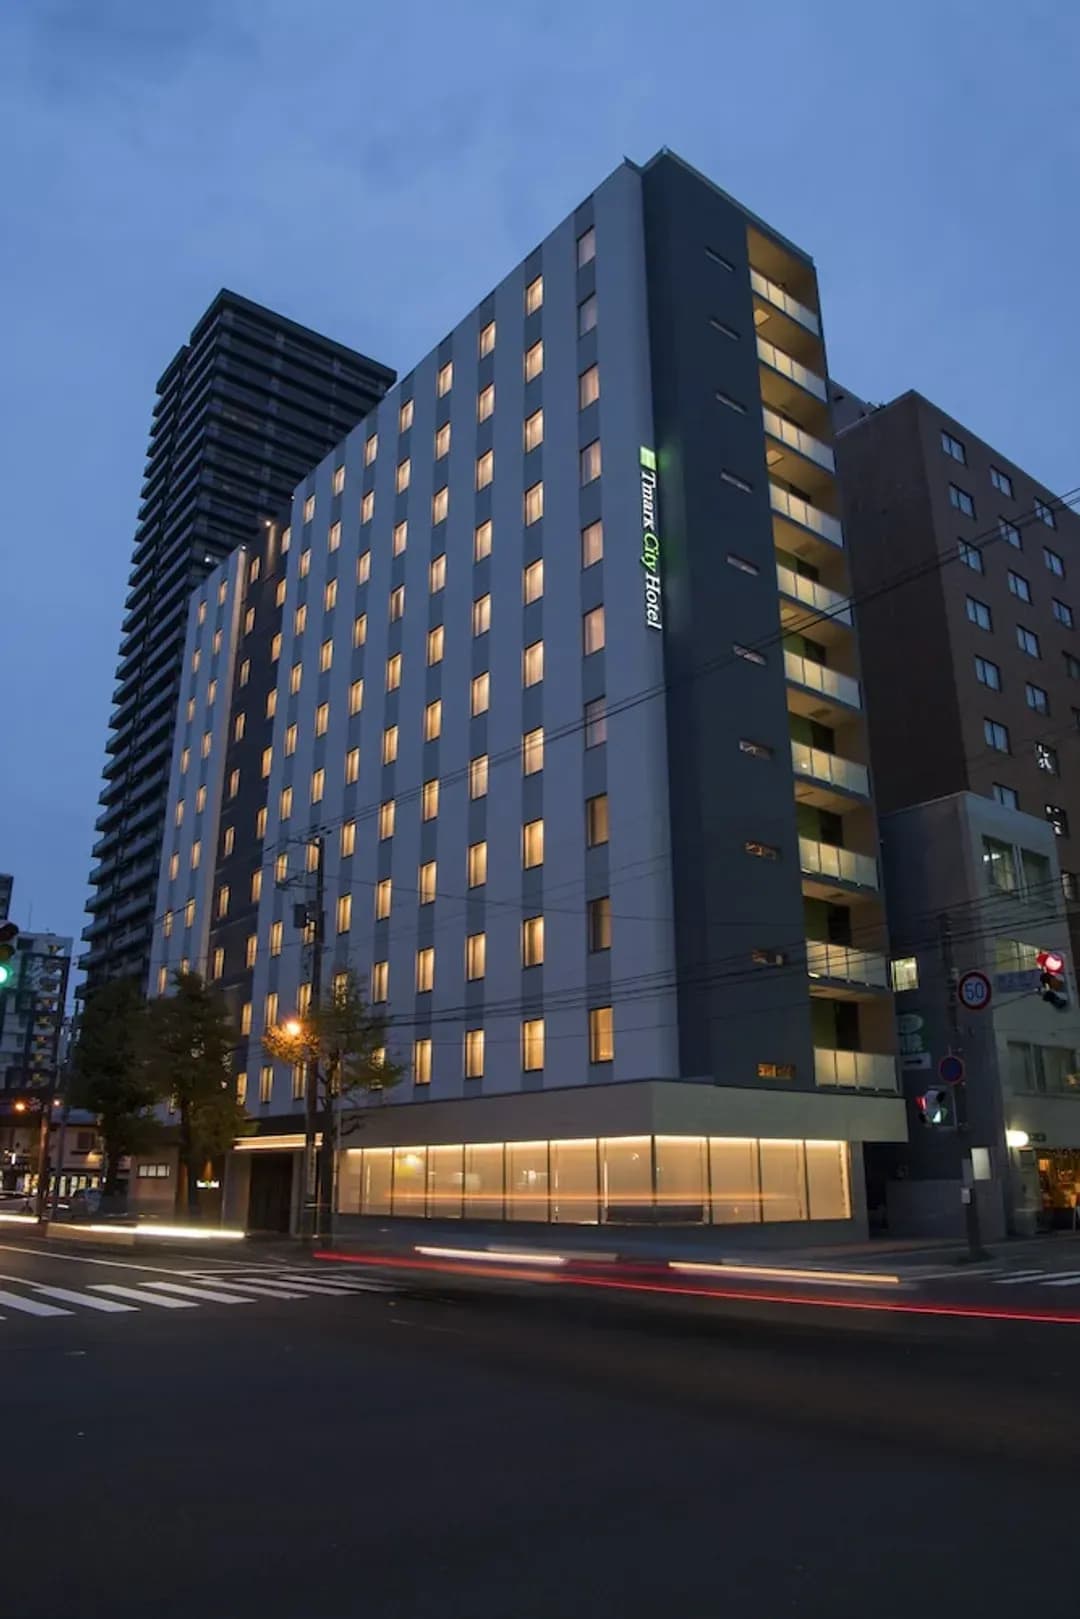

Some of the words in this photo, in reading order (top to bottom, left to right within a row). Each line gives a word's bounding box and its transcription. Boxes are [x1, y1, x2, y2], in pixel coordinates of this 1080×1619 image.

[641, 471, 656, 530] Tmark
[640, 533, 659, 572] City
[645, 572, 662, 630] Hotel
[965, 982, 984, 1000] 50
